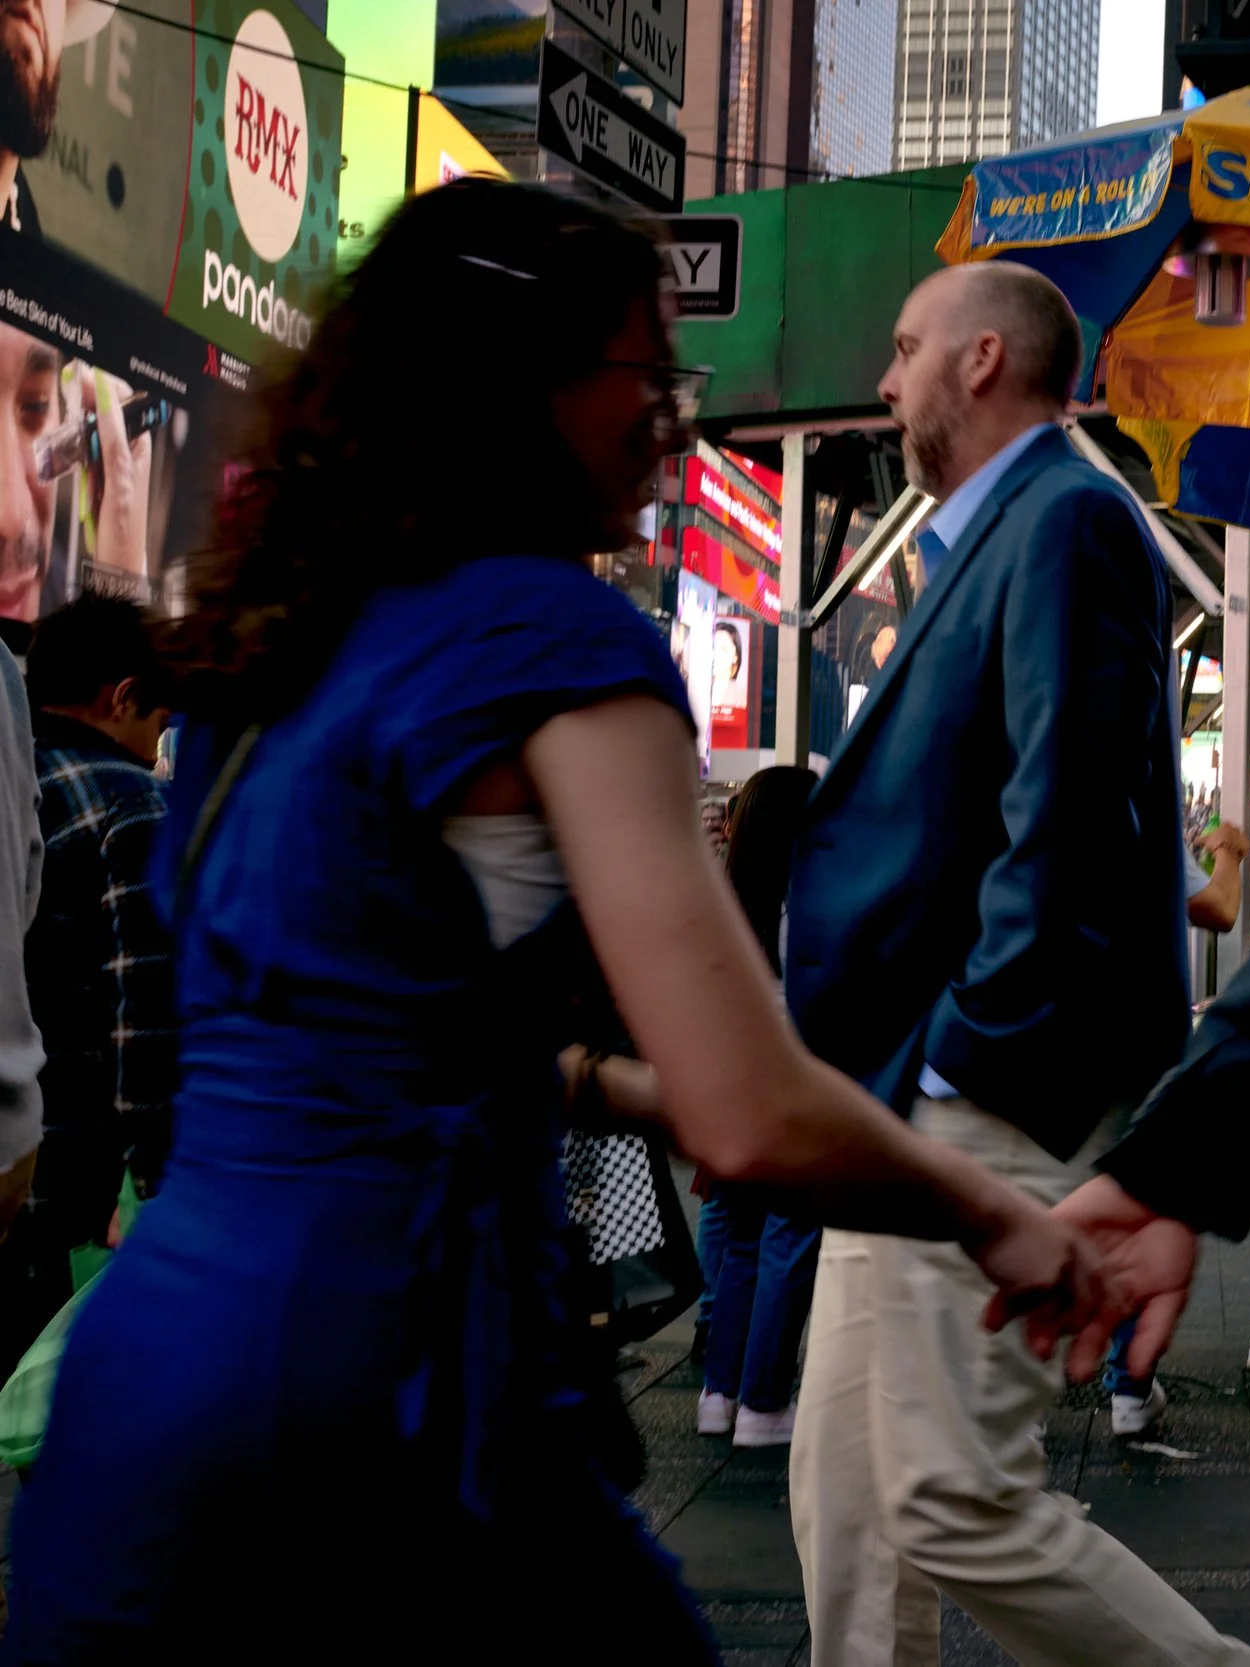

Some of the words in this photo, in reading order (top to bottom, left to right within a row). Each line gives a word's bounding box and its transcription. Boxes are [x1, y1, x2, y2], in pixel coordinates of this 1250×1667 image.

[631, 10, 677, 79] ONLY
[235, 72, 300, 201] RMX
[565, 91, 609, 153] ONE
[628, 130, 669, 190] WAY
[988, 191, 1048, 218] WE'RE
[1050, 186, 1076, 212] ON
[1095, 175, 1135, 205] ROLL
